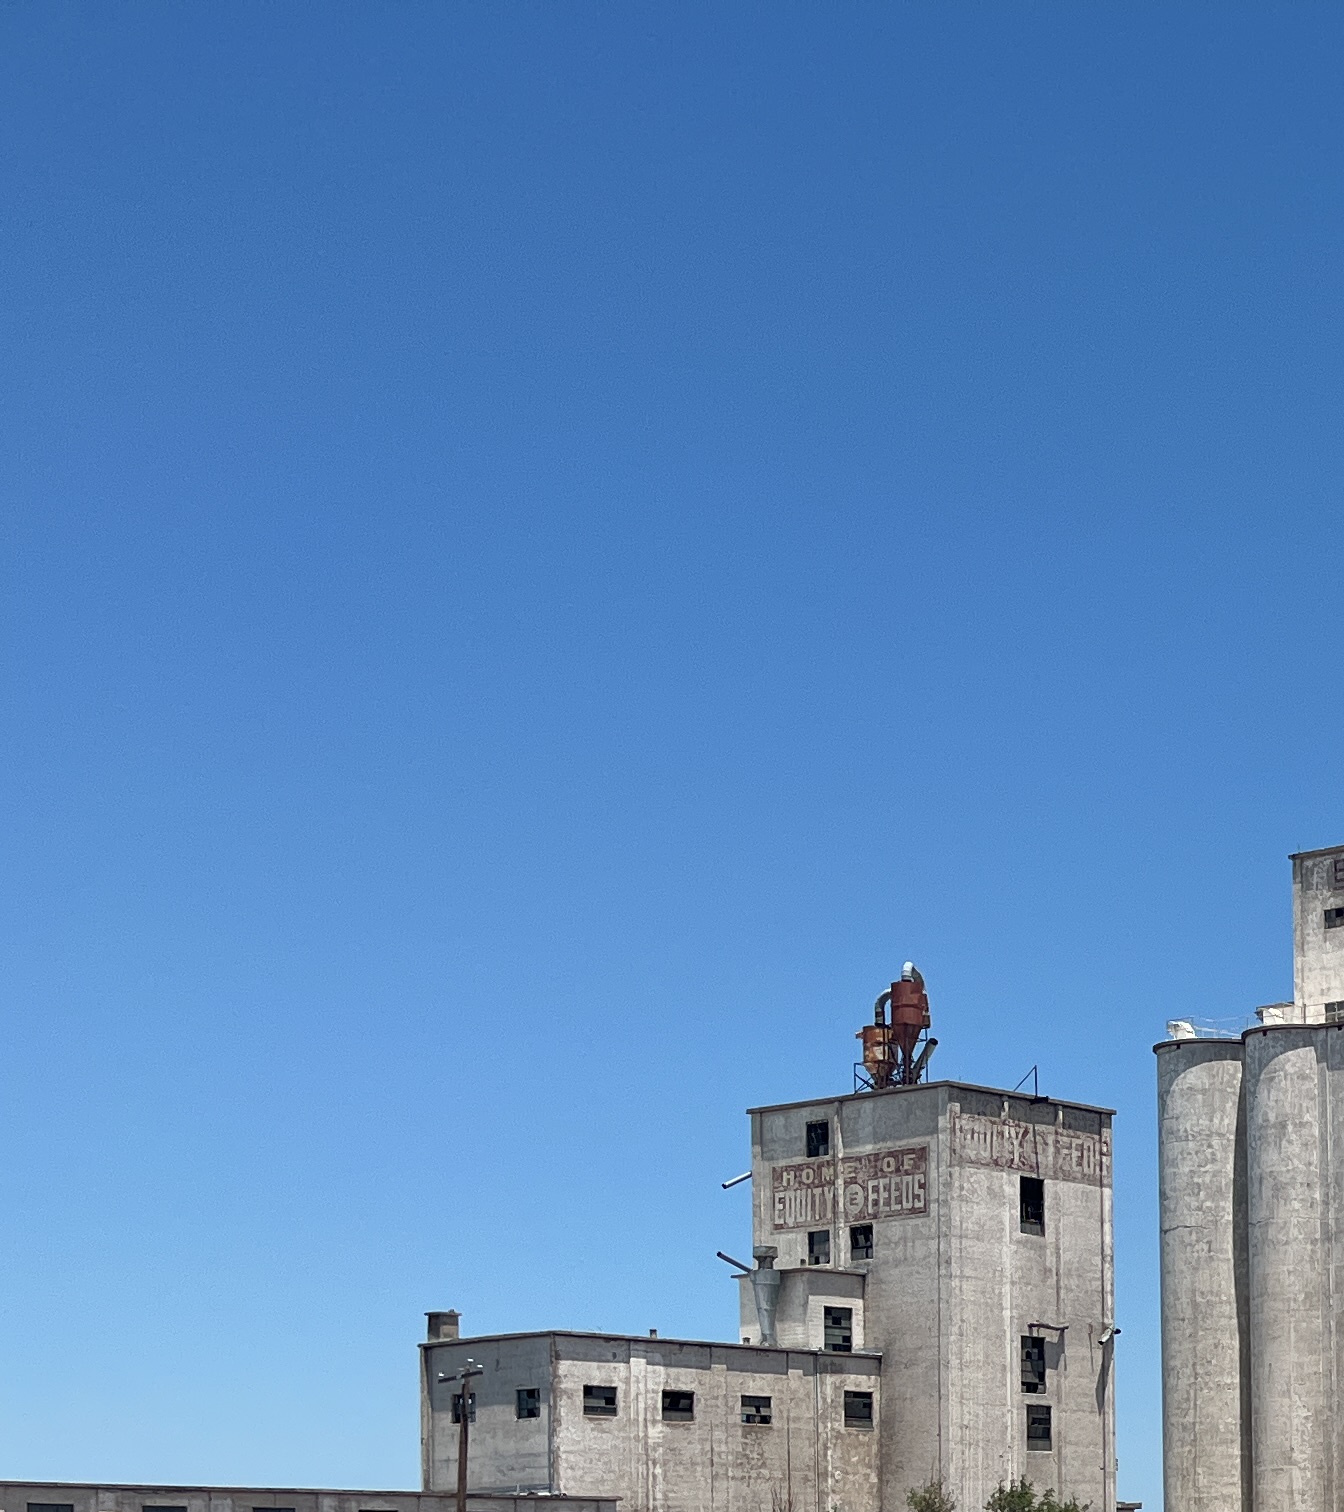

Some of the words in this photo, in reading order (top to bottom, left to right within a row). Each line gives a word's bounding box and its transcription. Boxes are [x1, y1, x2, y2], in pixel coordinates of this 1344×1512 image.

[782, 1161, 857, 1187] HOME
[882, 1153, 916, 1173] OF
[774, 1185, 835, 1228] EQUITY
[867, 1173, 926, 1215] FEEDS
